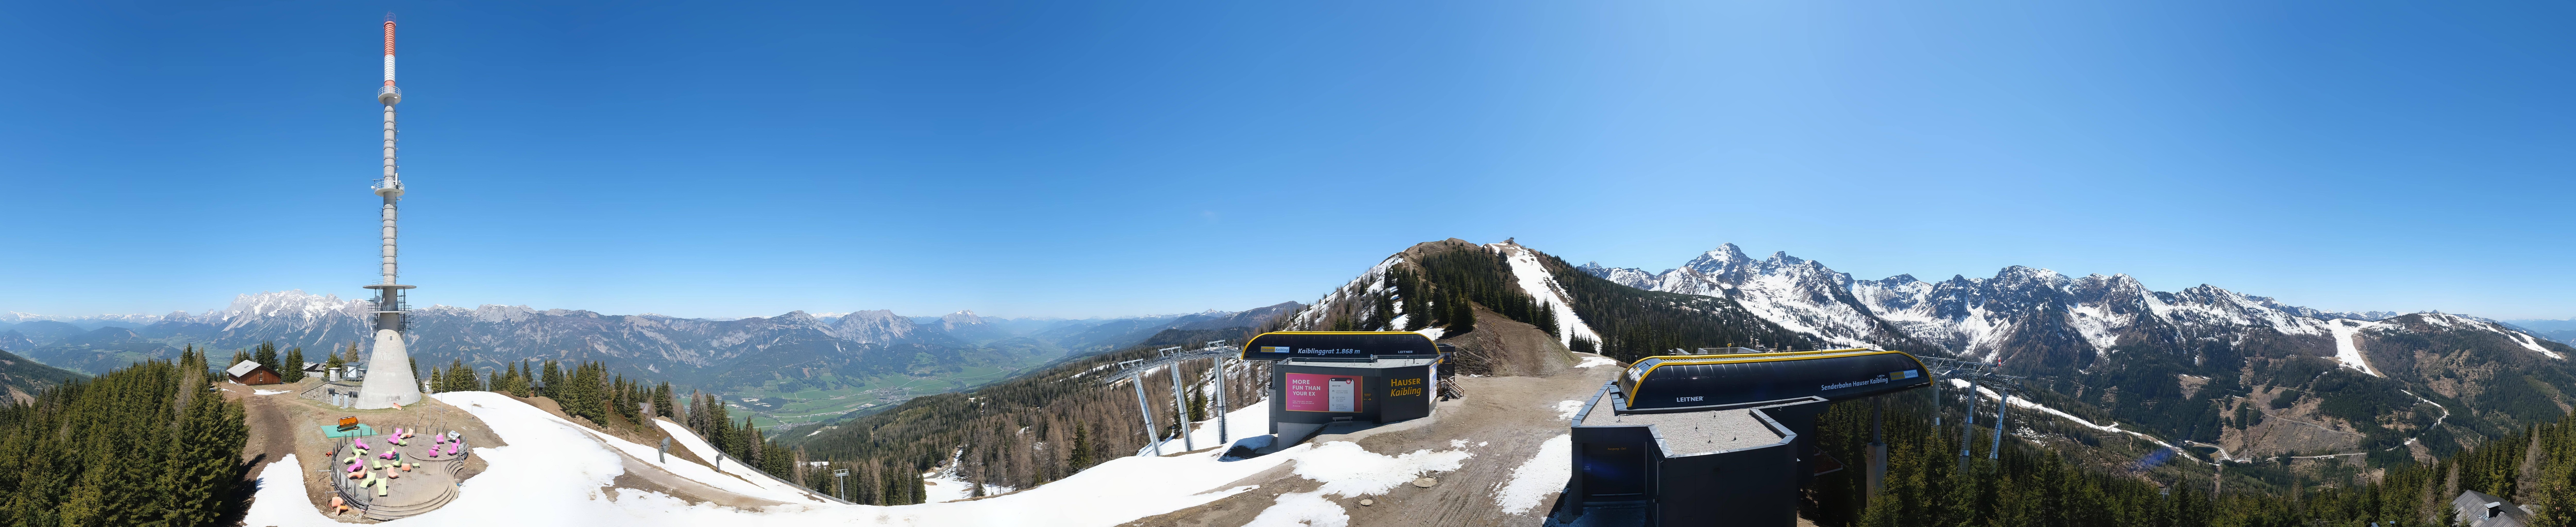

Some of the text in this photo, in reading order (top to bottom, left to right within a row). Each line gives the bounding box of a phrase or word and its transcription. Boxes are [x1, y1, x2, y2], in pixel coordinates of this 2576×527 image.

[1391, 378, 1421, 387] HAUSER
[1821, 382, 1852, 391] Senderbahn
[1391, 387, 1421, 397] Kaibling
